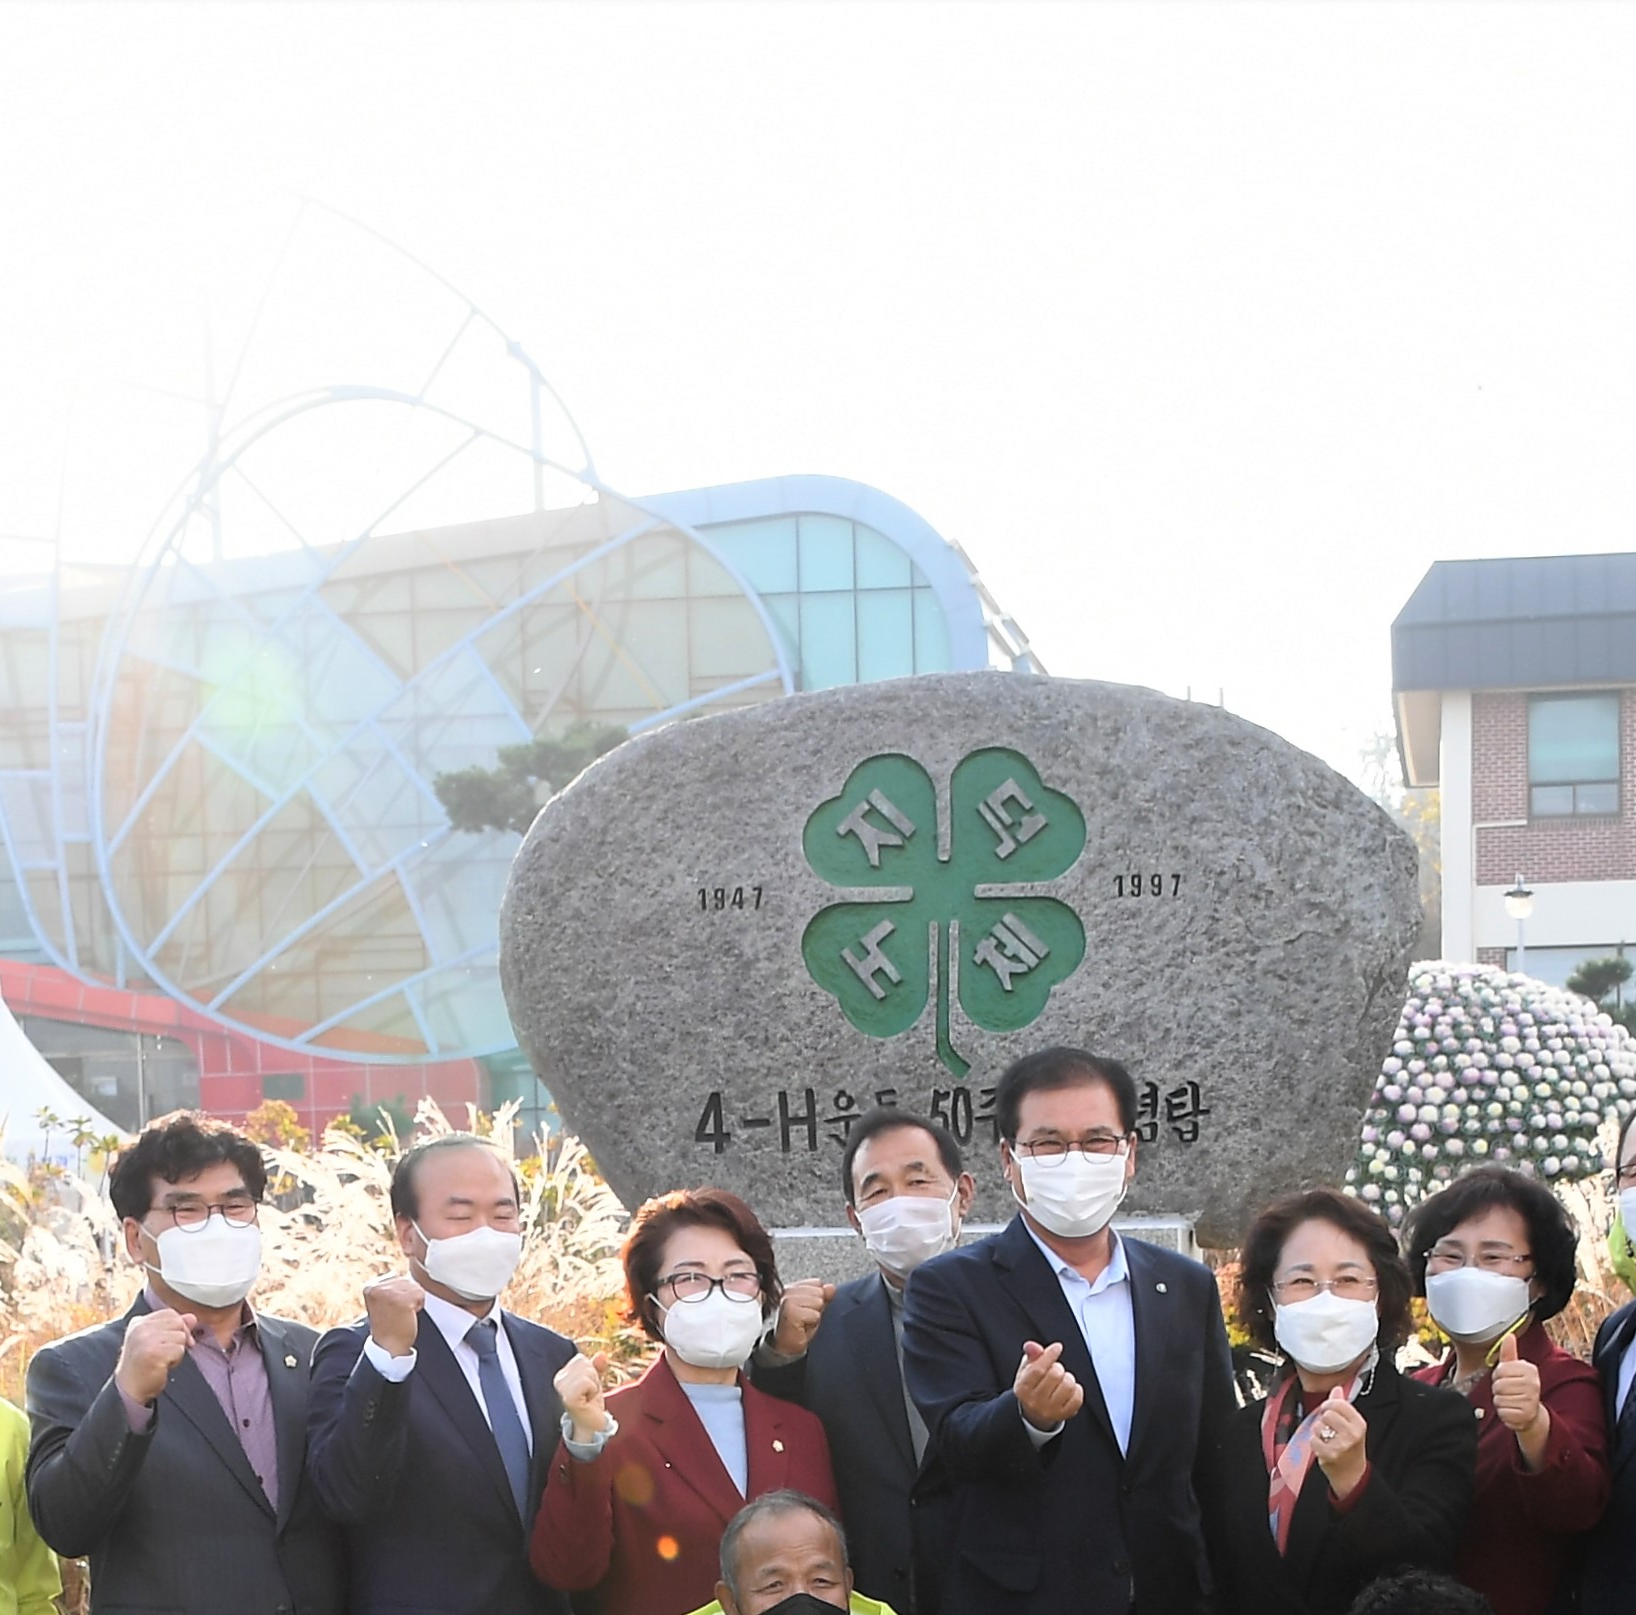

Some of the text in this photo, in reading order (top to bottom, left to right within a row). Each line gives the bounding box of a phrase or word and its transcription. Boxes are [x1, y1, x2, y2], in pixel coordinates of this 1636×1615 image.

[836, 788, 916, 868] 지
[697, 885, 763, 911] 1947
[1113, 872, 1181, 898] 1997
